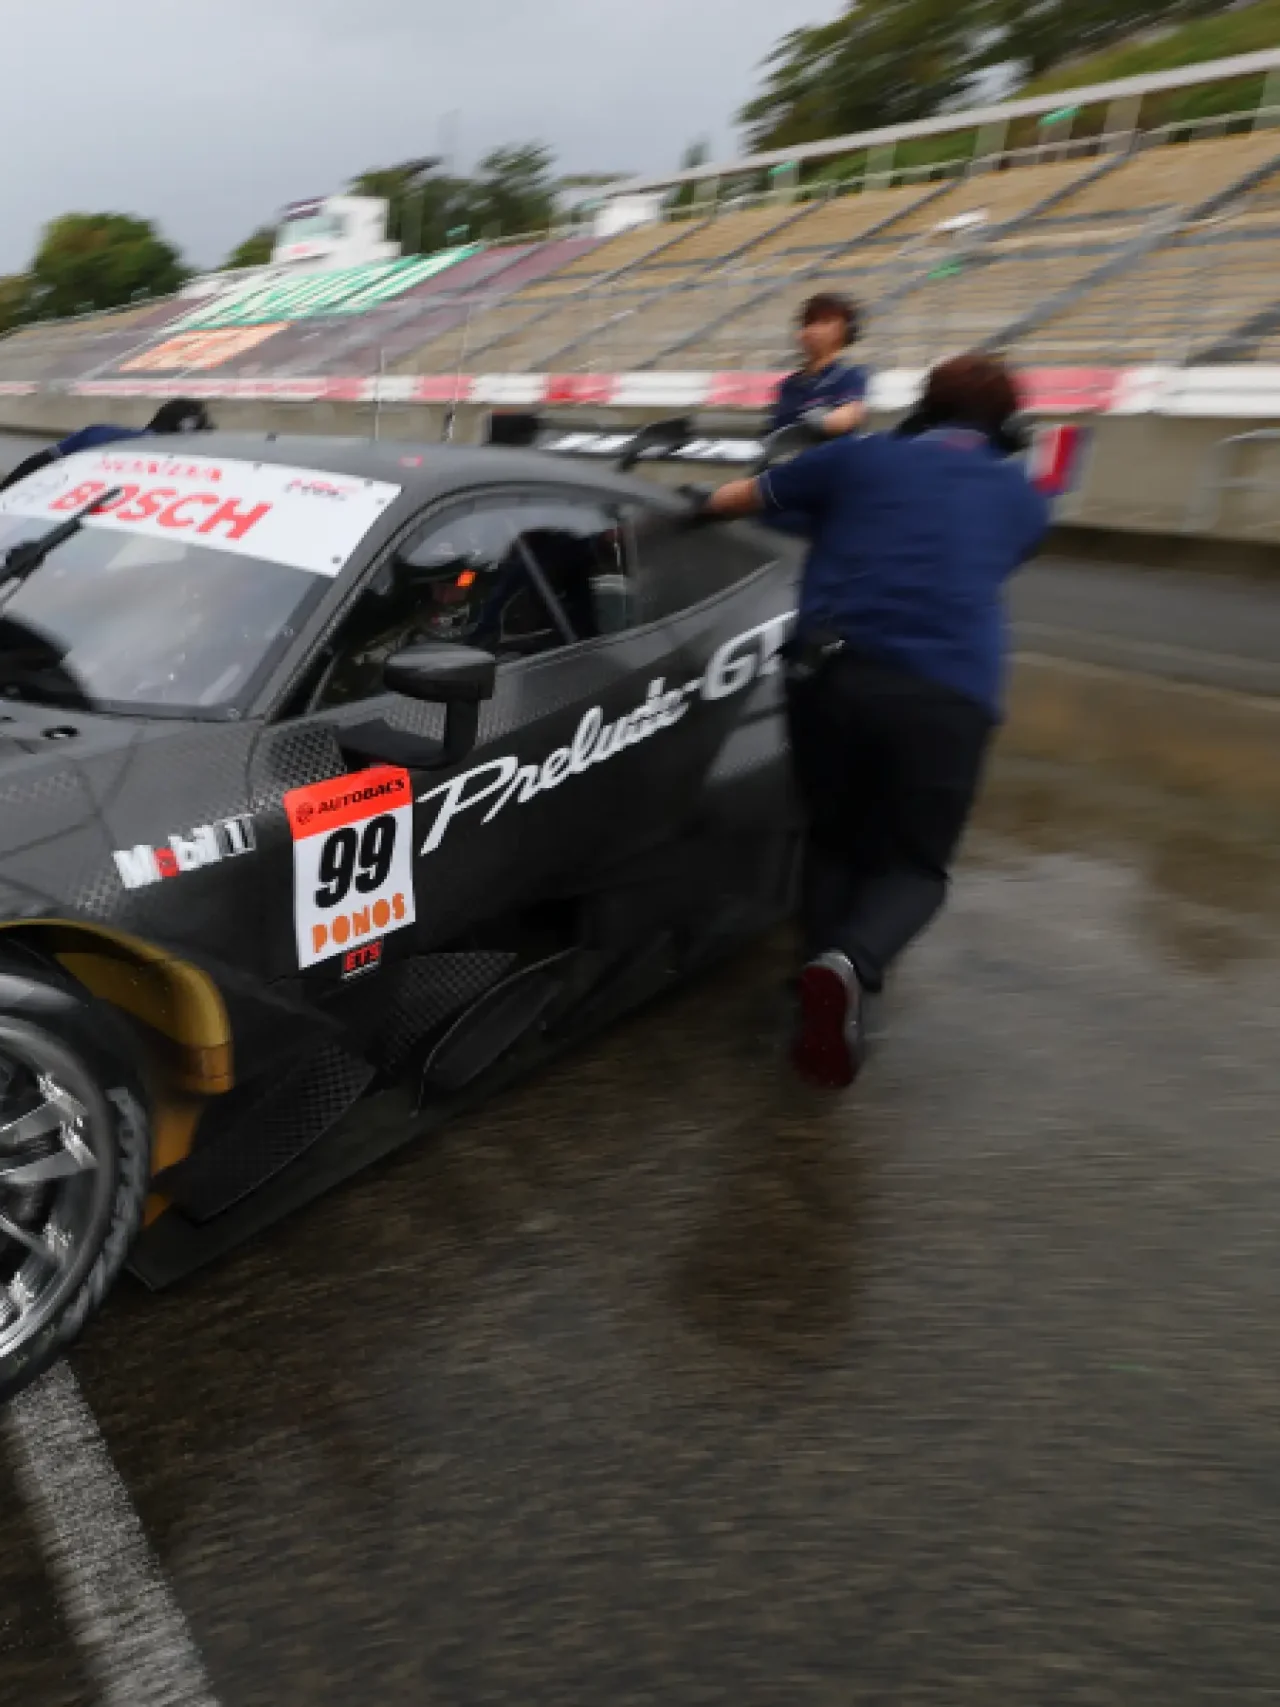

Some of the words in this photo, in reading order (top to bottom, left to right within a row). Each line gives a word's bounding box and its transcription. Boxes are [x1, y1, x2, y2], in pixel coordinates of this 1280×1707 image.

[48, 480, 274, 541] BOSCH
[317, 778, 405, 815] AUTOBACS
[112, 824, 222, 891] Mobil
[313, 813, 398, 909] 99
[312, 892, 407, 954] PONOS
